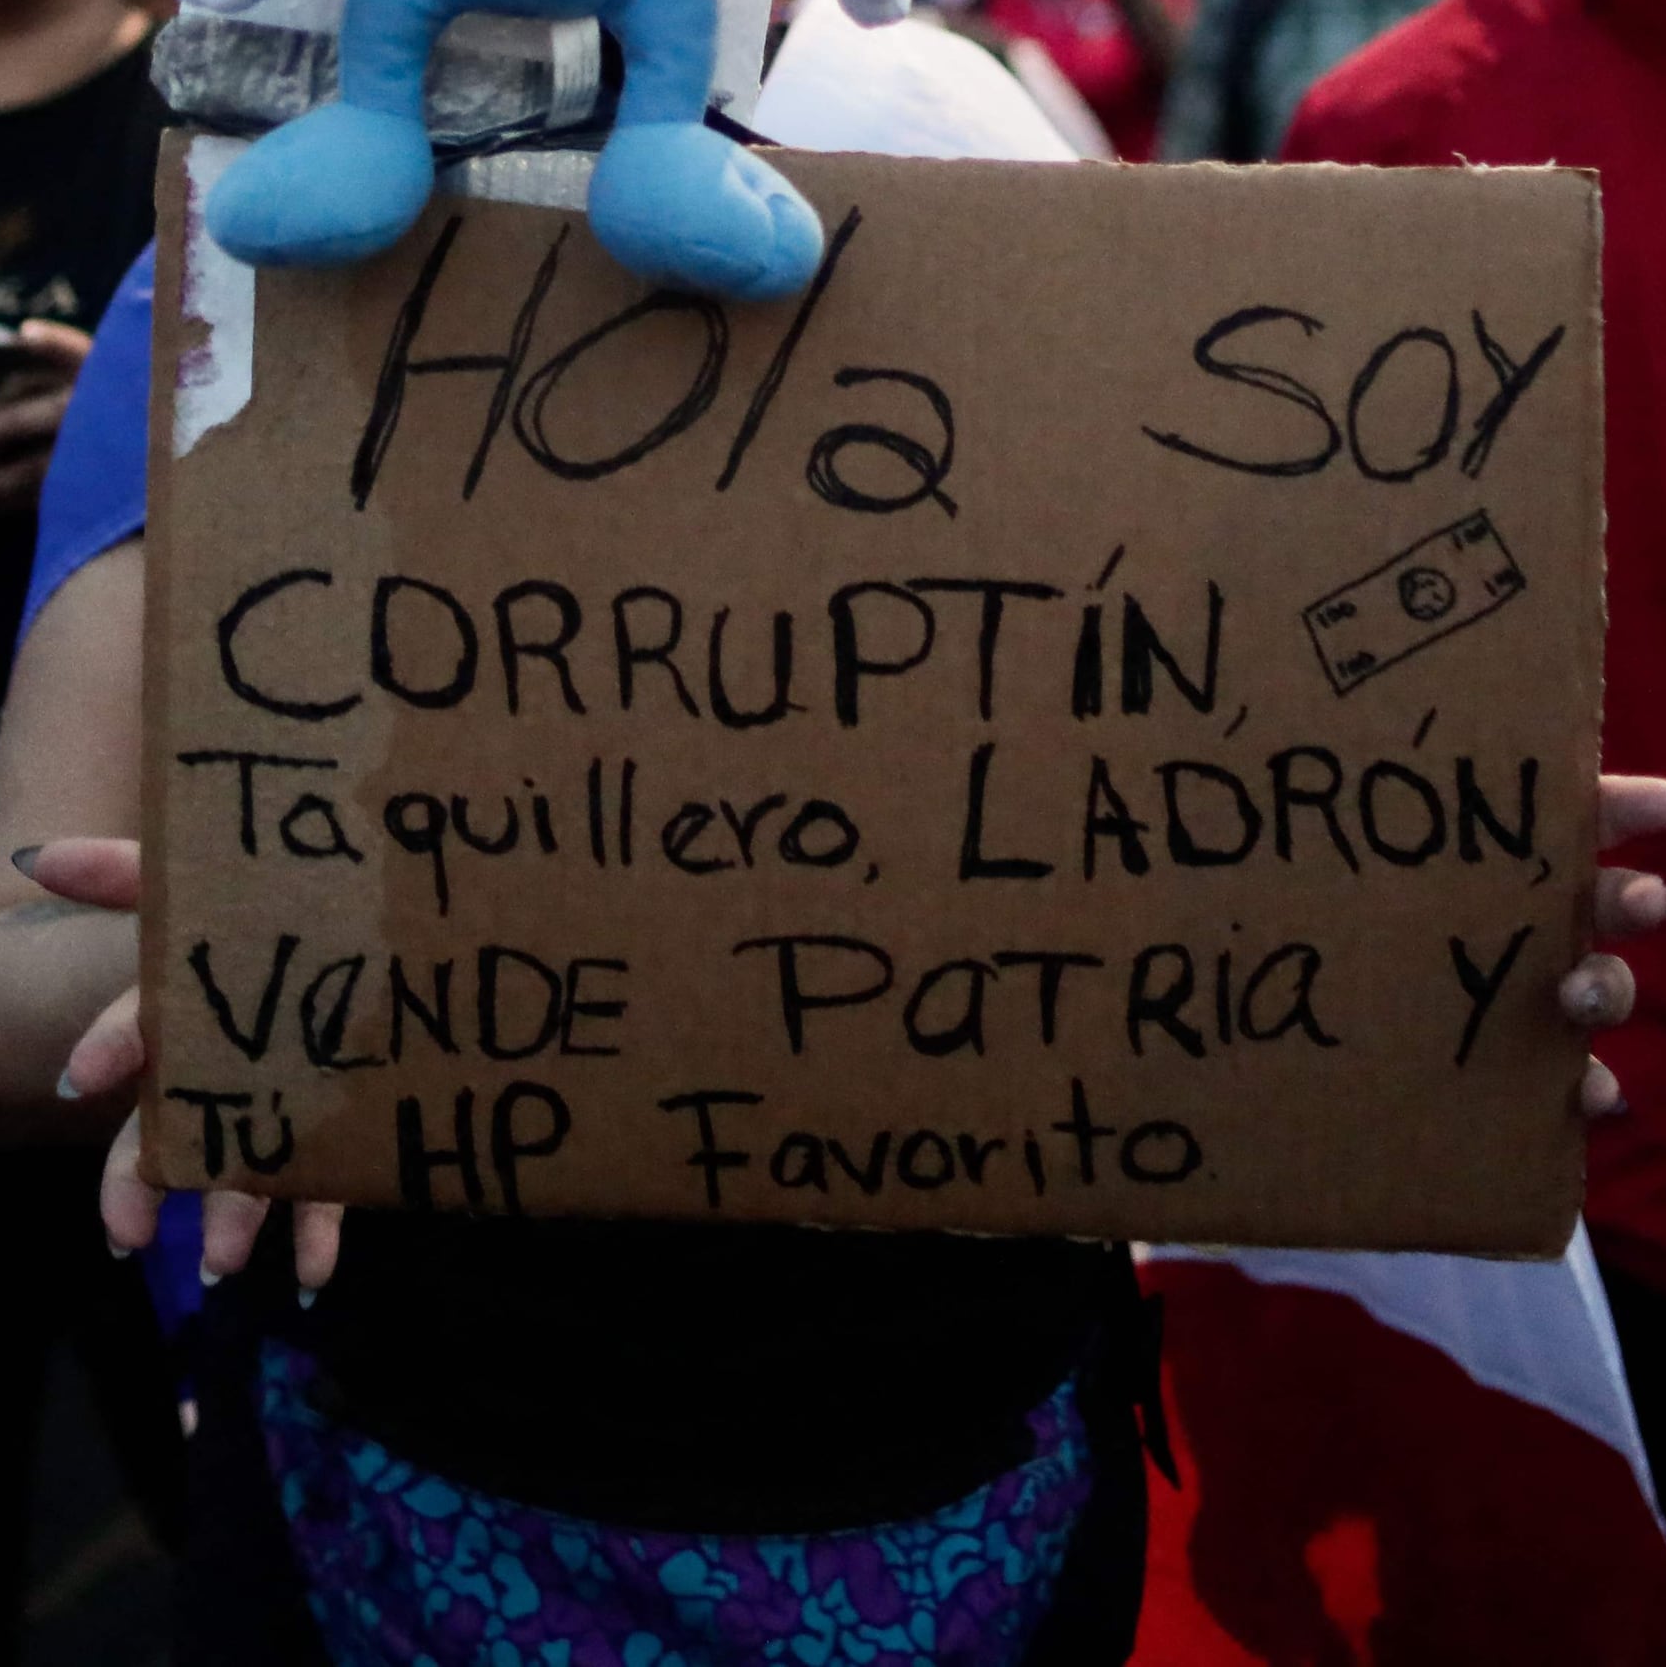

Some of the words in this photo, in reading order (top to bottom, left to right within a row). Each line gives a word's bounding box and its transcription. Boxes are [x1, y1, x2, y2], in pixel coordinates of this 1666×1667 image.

[1141, 305, 1566, 485] SOY
[216, 545, 1249, 739] CORRUPTÍN,
[958, 707, 1553, 888] LADRÓN,
[395, 1080, 573, 1215] HP
